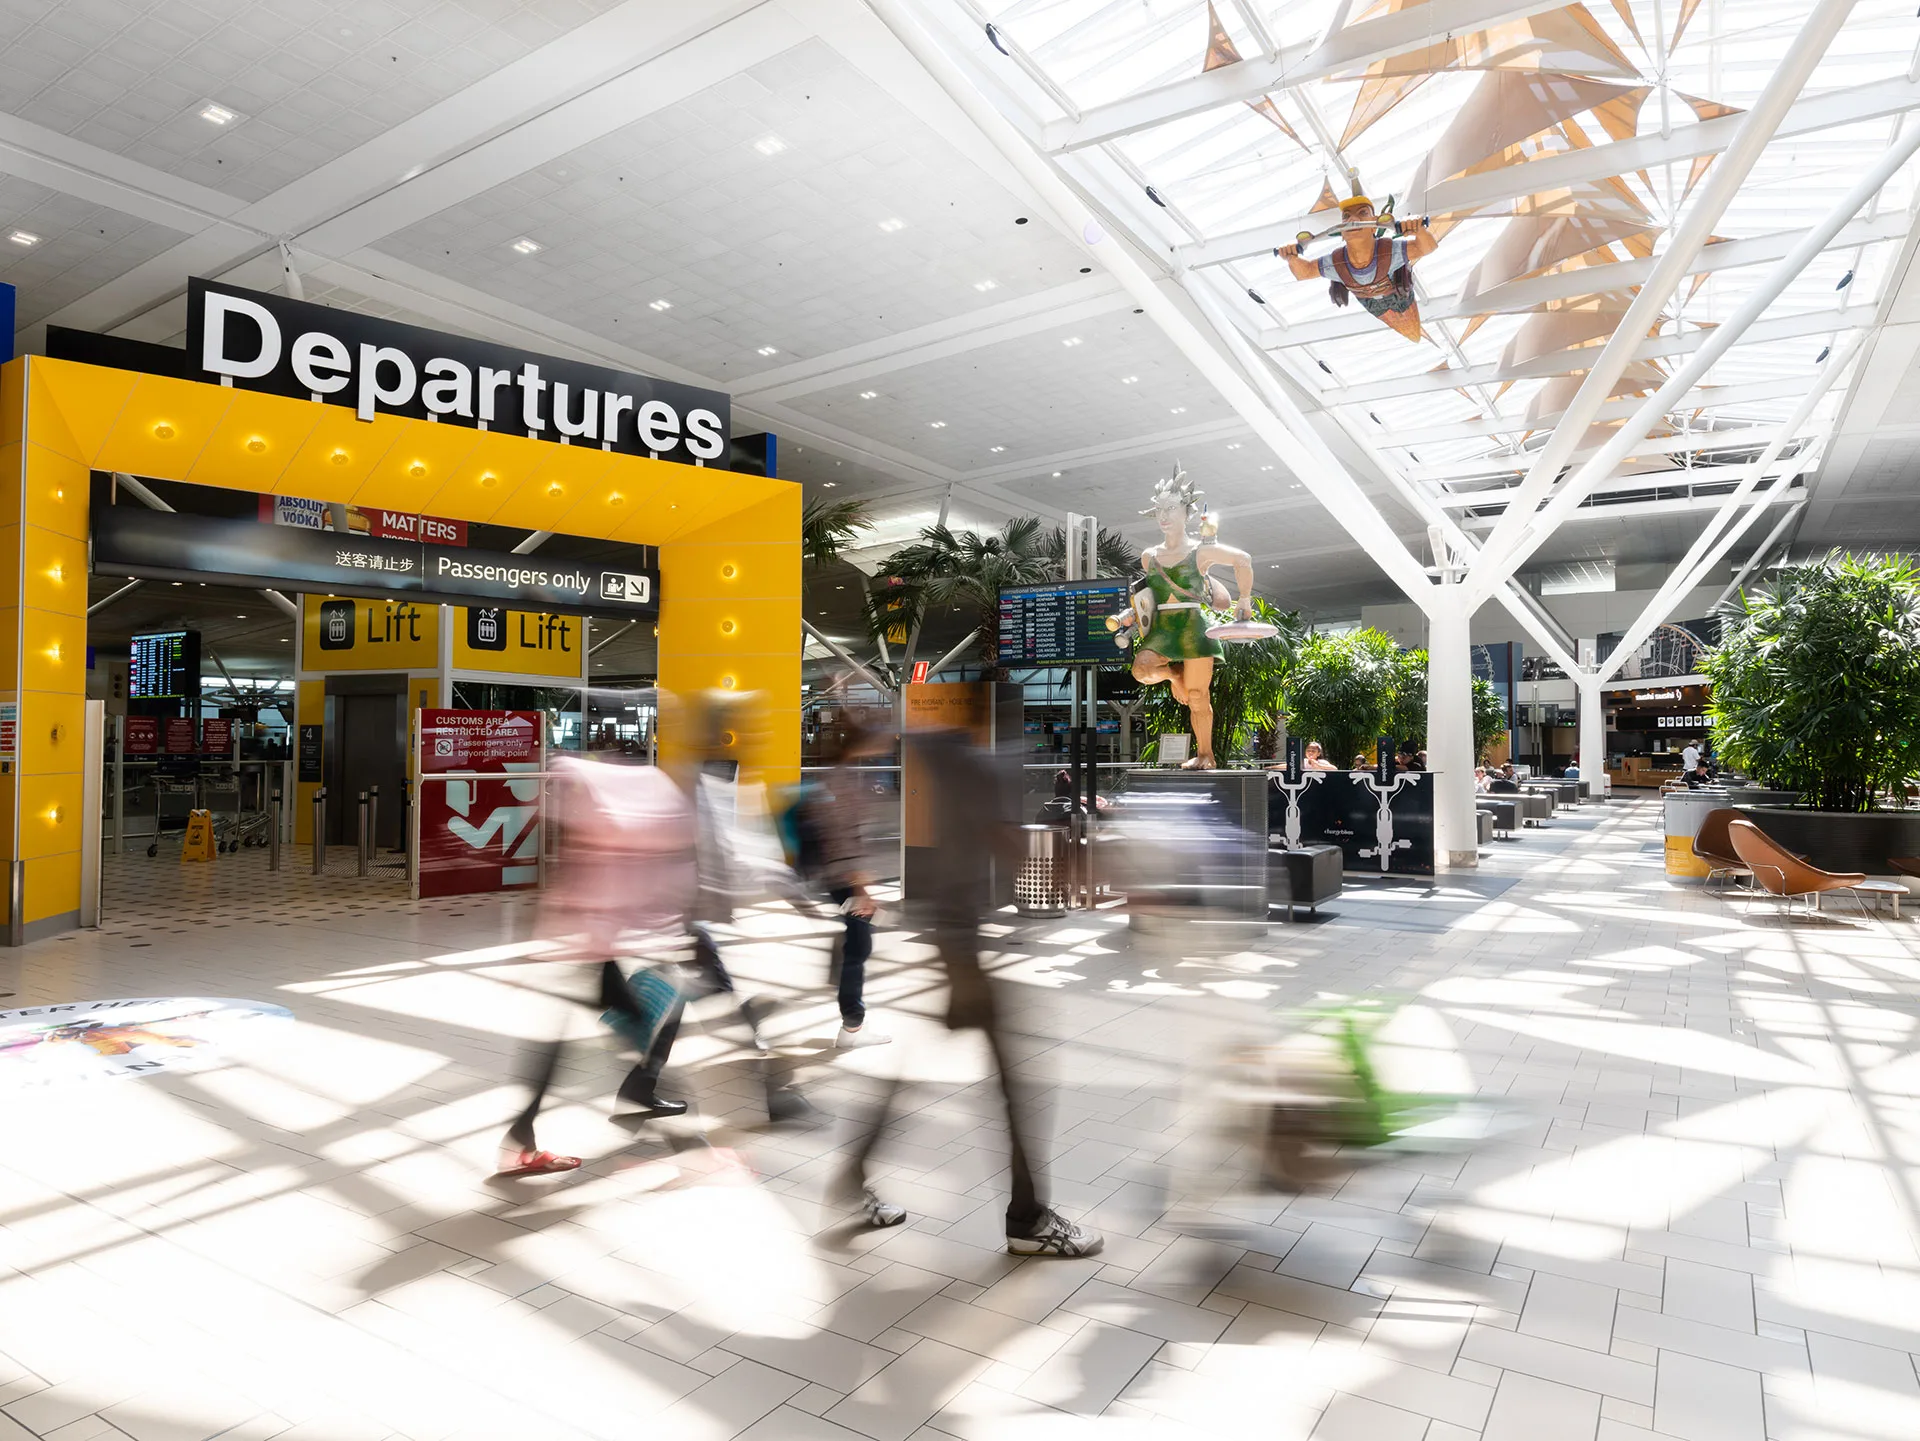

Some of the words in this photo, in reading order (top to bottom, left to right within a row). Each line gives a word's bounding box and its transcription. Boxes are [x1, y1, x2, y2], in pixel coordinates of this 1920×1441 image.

[203, 291, 724, 459] Departures
[279, 496, 323, 513] ABSOLUT
[283, 512, 319, 528] VODKA
[382, 511, 457, 540] MATTERS
[335, 551, 414, 572] 送客请止步
[438, 557, 548, 588] Passengers
[553, 571, 591, 595] only
[367, 600, 421, 643] Lift
[520, 614, 571, 652] Lift
[435, 716, 484, 725] CUSTOMS
[485, 717, 510, 726] AREA
[1135, 722, 1142, 731] 2
[306, 727, 313, 740] 4
[435, 727, 493, 736] RESTRICTED
[495, 728, 519, 736] AREA
[458, 738, 504, 748] Passengers
[505, 739, 523, 747] only
[458, 749, 489, 758] beyond
[507, 749, 528, 758] point
